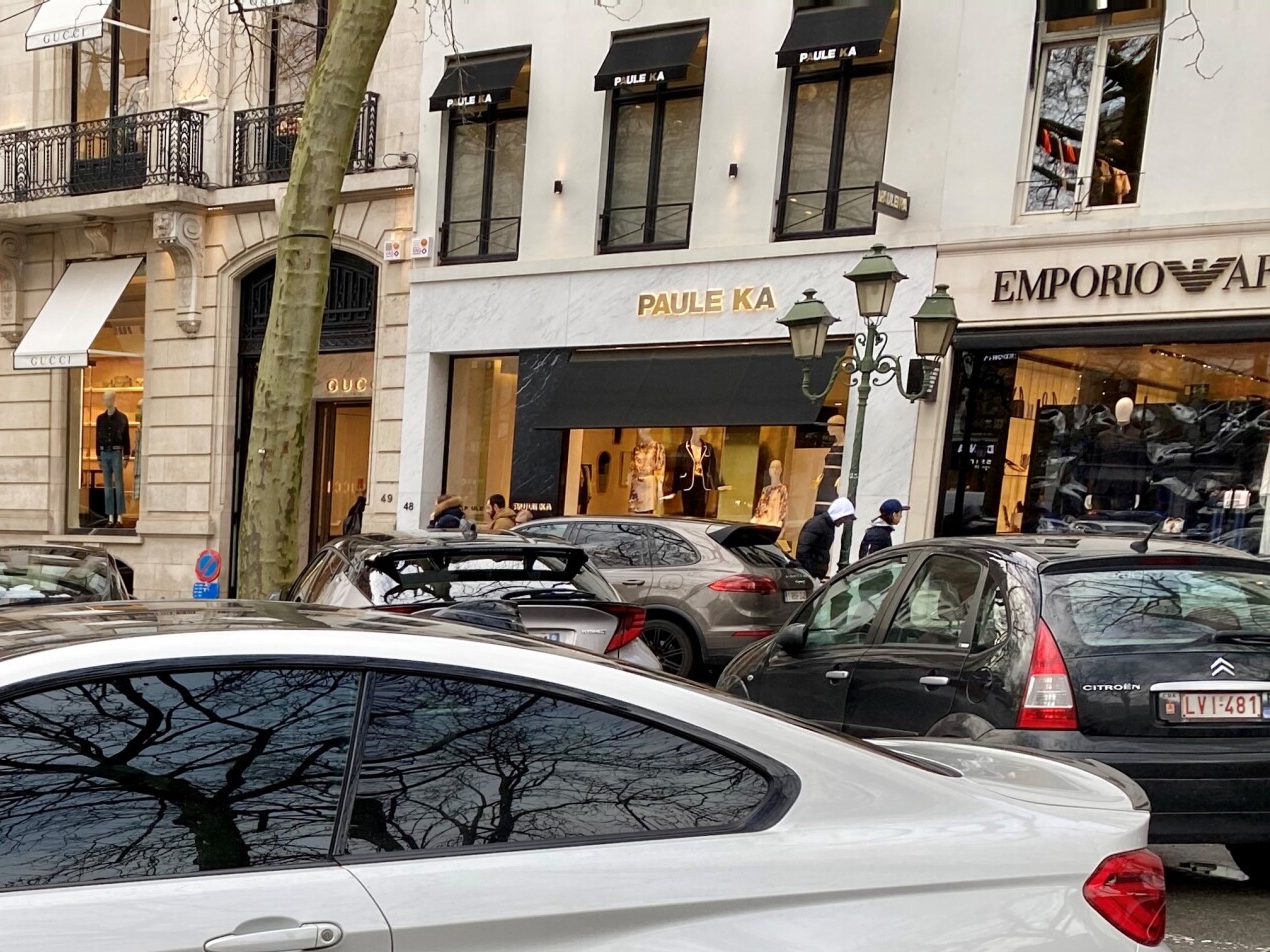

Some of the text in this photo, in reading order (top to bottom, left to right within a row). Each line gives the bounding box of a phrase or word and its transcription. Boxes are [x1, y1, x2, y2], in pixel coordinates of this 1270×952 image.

[43, 27, 86, 44] GUCCI
[799, 45, 857, 63] PAULE KA
[613, 70, 665, 88] PAULE KA
[446, 95, 476, 109] PAULE
[991, 260, 1165, 303] EMPORIO
[637, 285, 776, 317] PAULE KA
[30, 355, 72, 367] GUCCI
[327, 376, 374, 394] GUC
[380, 494, 393, 503] 49
[403, 502, 414, 511] 48
[1082, 682, 1141, 691] CITROËN
[1185, 695, 1257, 715] LVI-481
